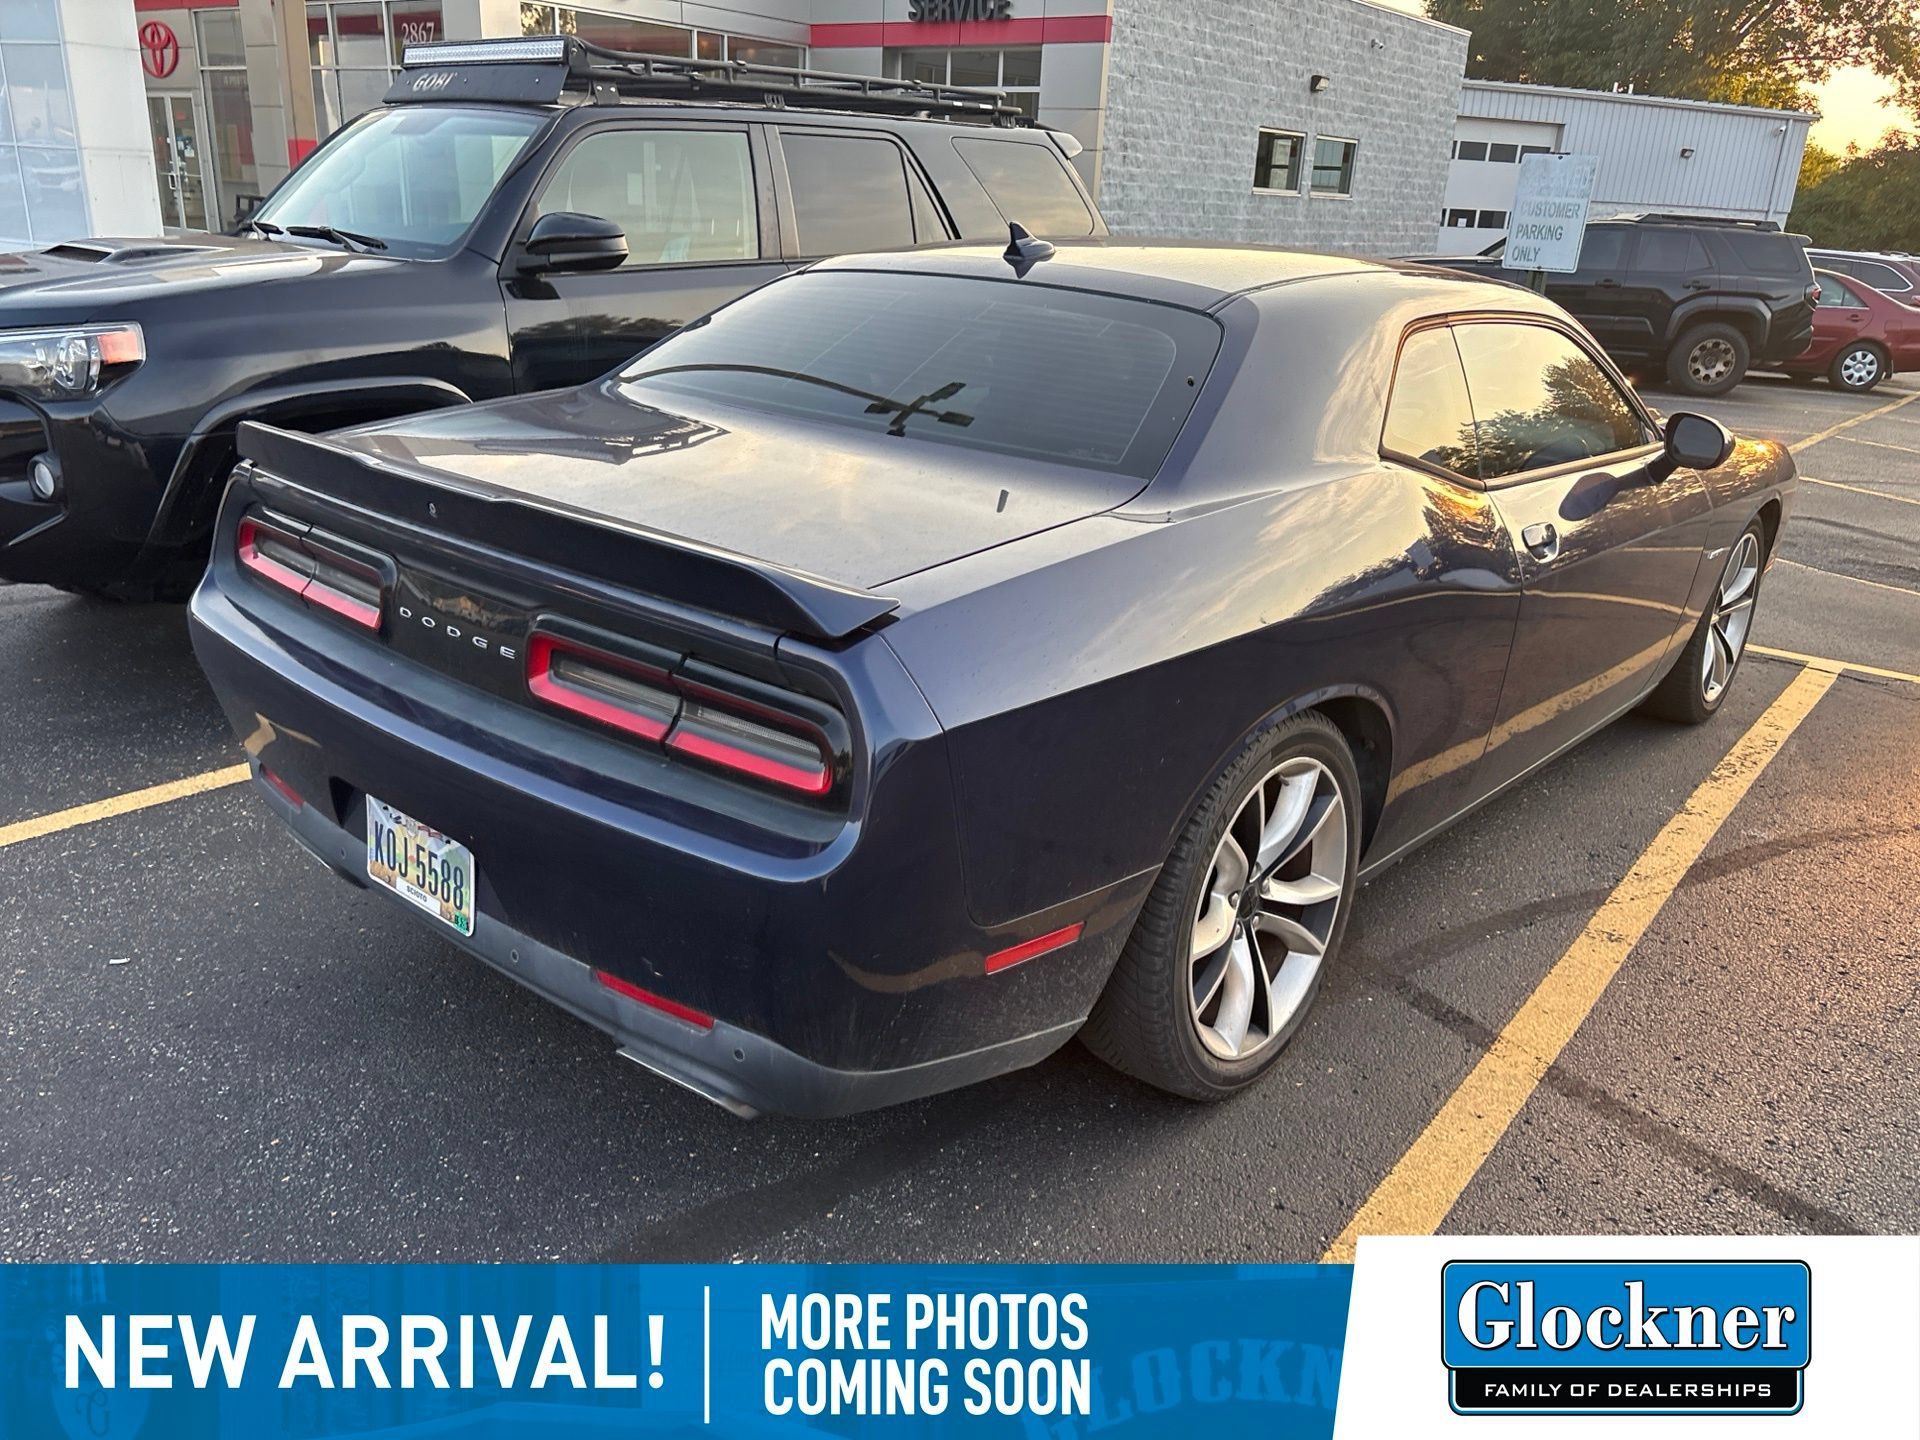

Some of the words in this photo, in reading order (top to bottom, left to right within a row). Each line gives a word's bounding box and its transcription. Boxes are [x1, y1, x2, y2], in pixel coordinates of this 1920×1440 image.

[908, 0, 1011, 22] SERVICE
[401, 22, 434, 44] 2867
[412, 72, 454, 91] GOBI
[1519, 201, 1581, 219] CUSTOMER
[1515, 223, 1564, 241] PARKING
[1511, 245, 1541, 262] ONLY
[399, 606, 516, 660] DODGE
[374, 820, 408, 878] KOJ
[415, 843, 464, 911] 5588
